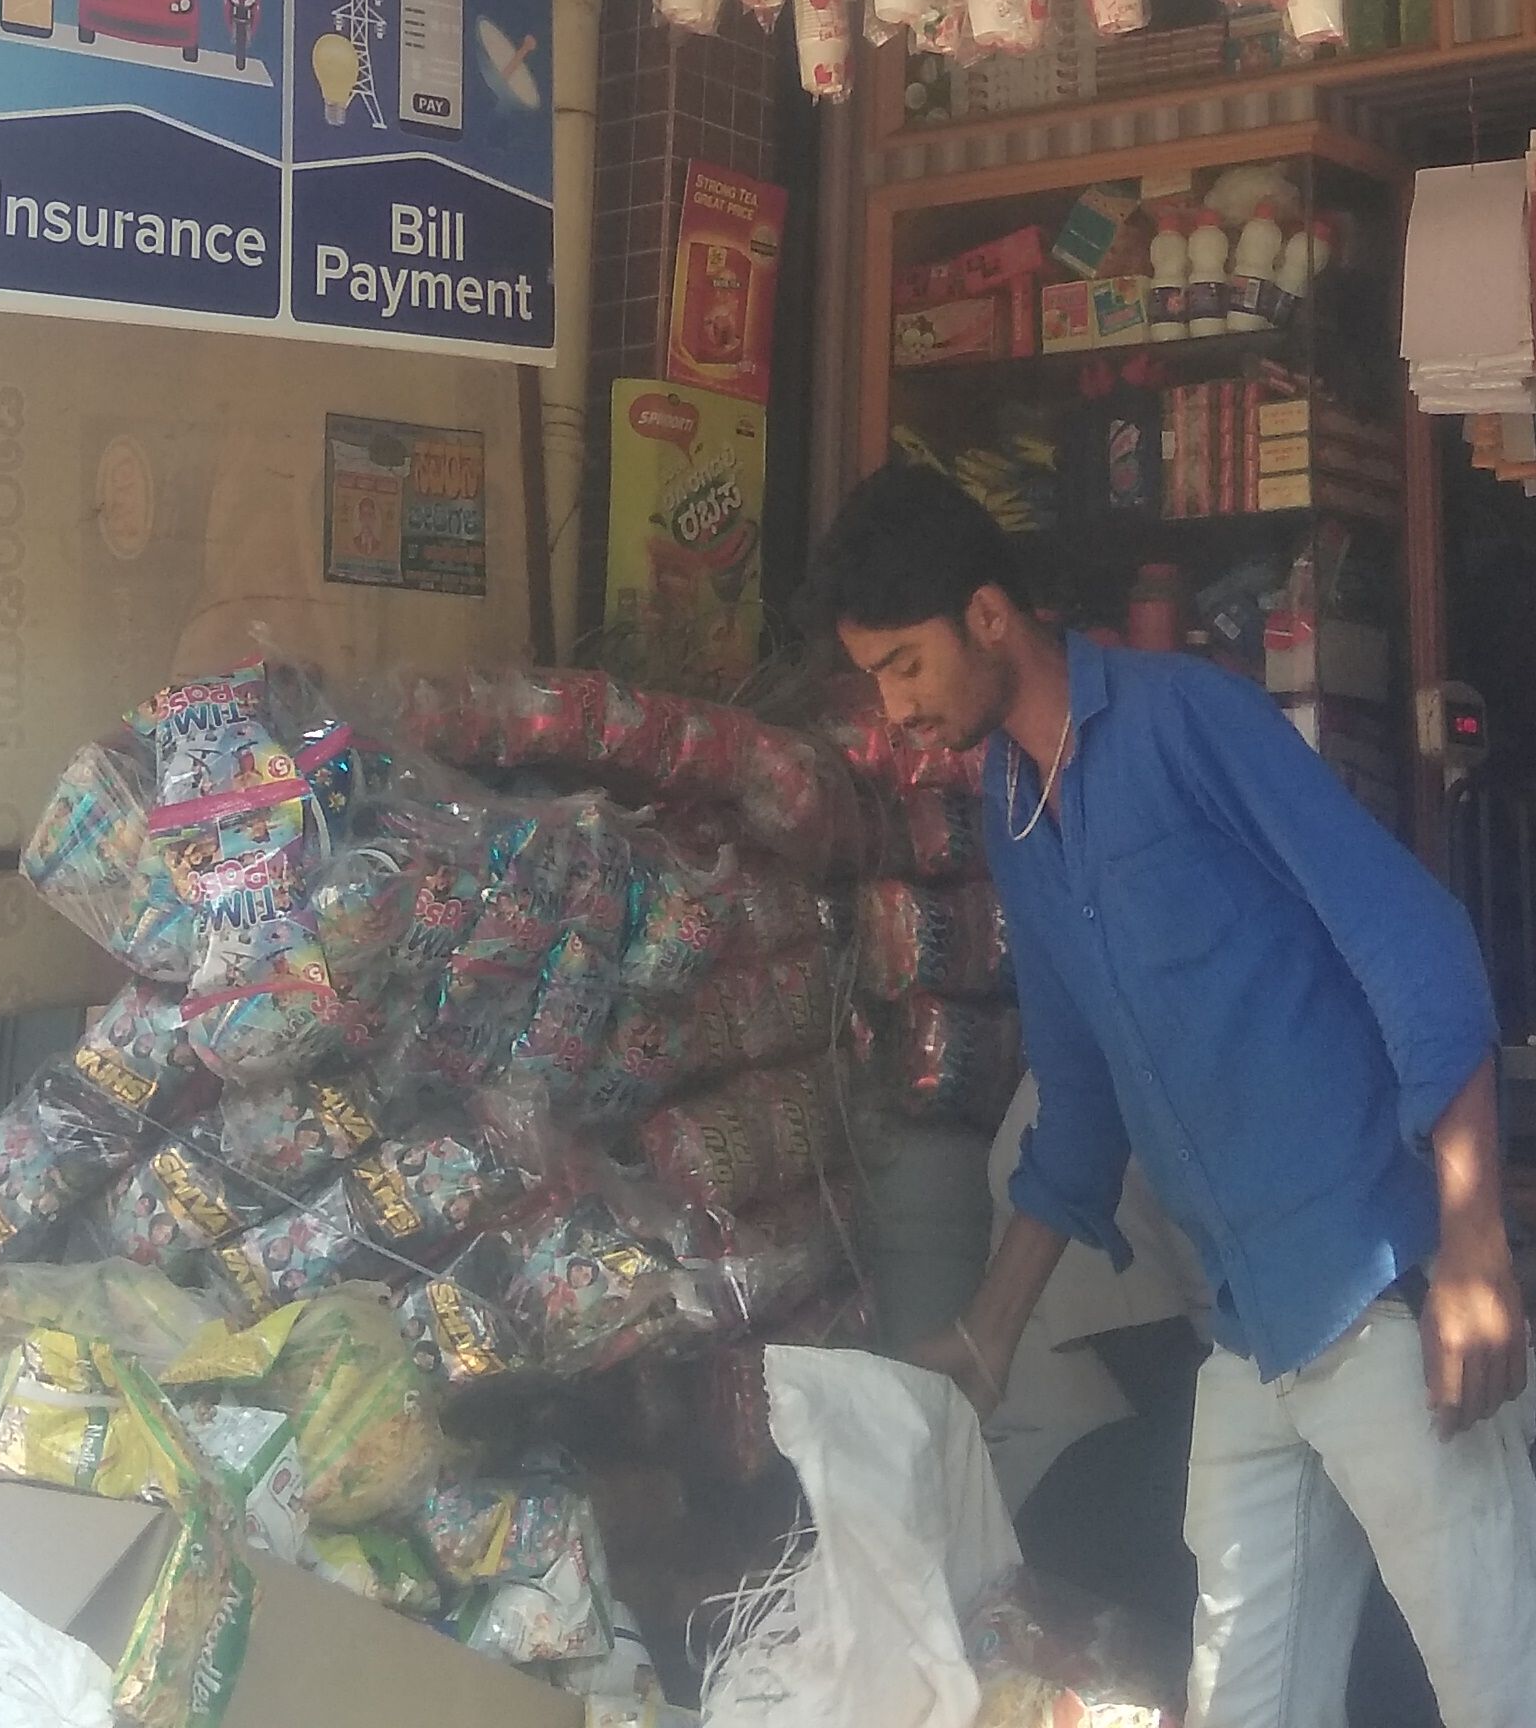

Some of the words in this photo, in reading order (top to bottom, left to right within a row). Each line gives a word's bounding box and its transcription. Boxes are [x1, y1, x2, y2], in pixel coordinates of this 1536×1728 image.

[416, 95, 447, 114] PAY
[693, 191, 725, 212] GREAT
[727, 201, 755, 221] PRICE
[695, 174, 736, 200] STRONG
[739, 188, 759, 206] TEA
[388, 201, 466, 264] Bill
[313, 246, 534, 324] Payment
[191, 1581, 244, 1715] Noodles
